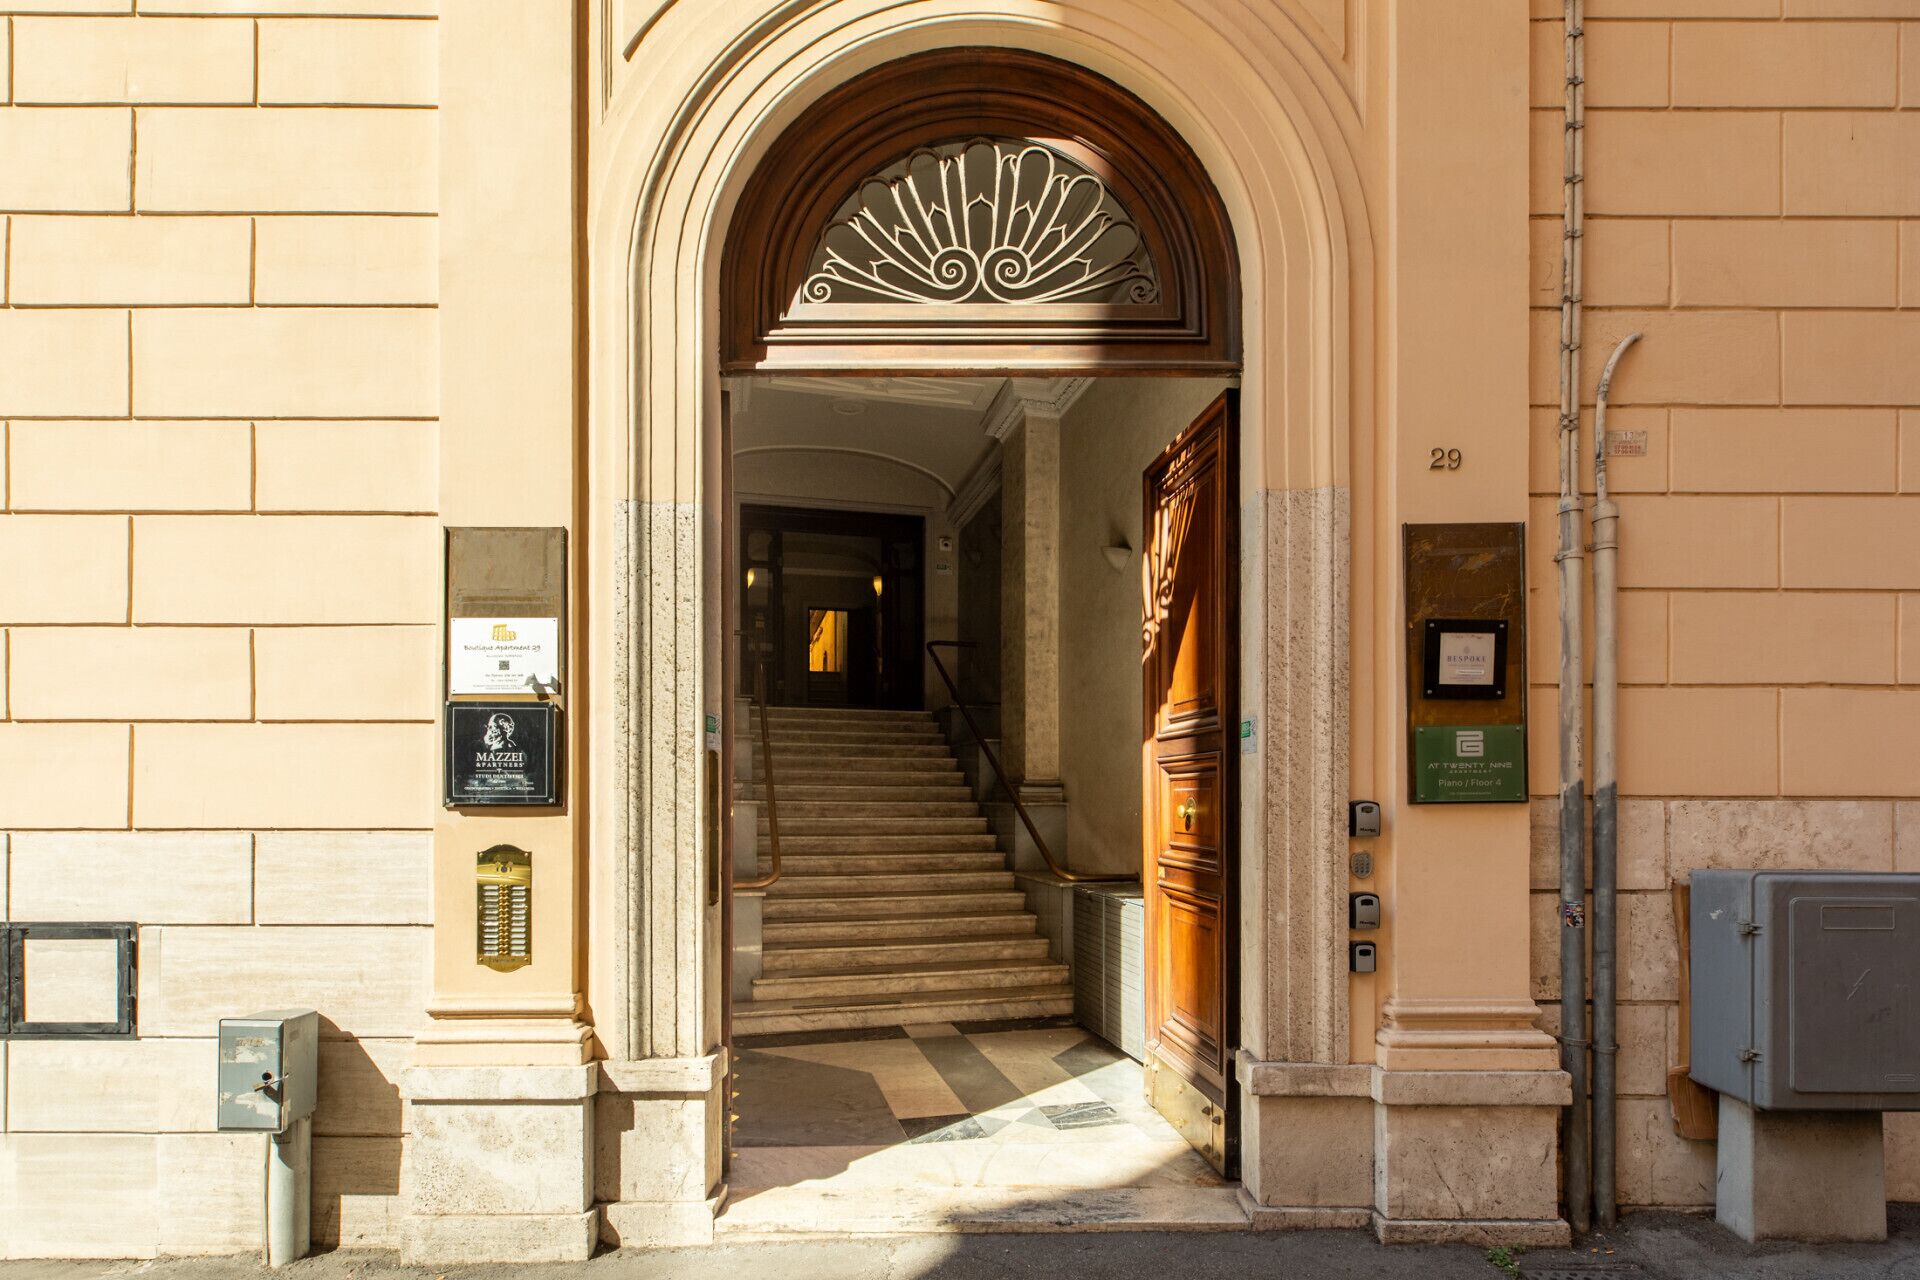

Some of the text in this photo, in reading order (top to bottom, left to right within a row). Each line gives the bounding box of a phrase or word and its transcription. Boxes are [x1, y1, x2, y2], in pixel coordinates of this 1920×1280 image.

[1430, 448, 1461, 470] 29
[475, 752, 523, 761] MAZZEI
[1438, 779, 1463, 787] Piano
[1465, 779, 1469, 787] /
